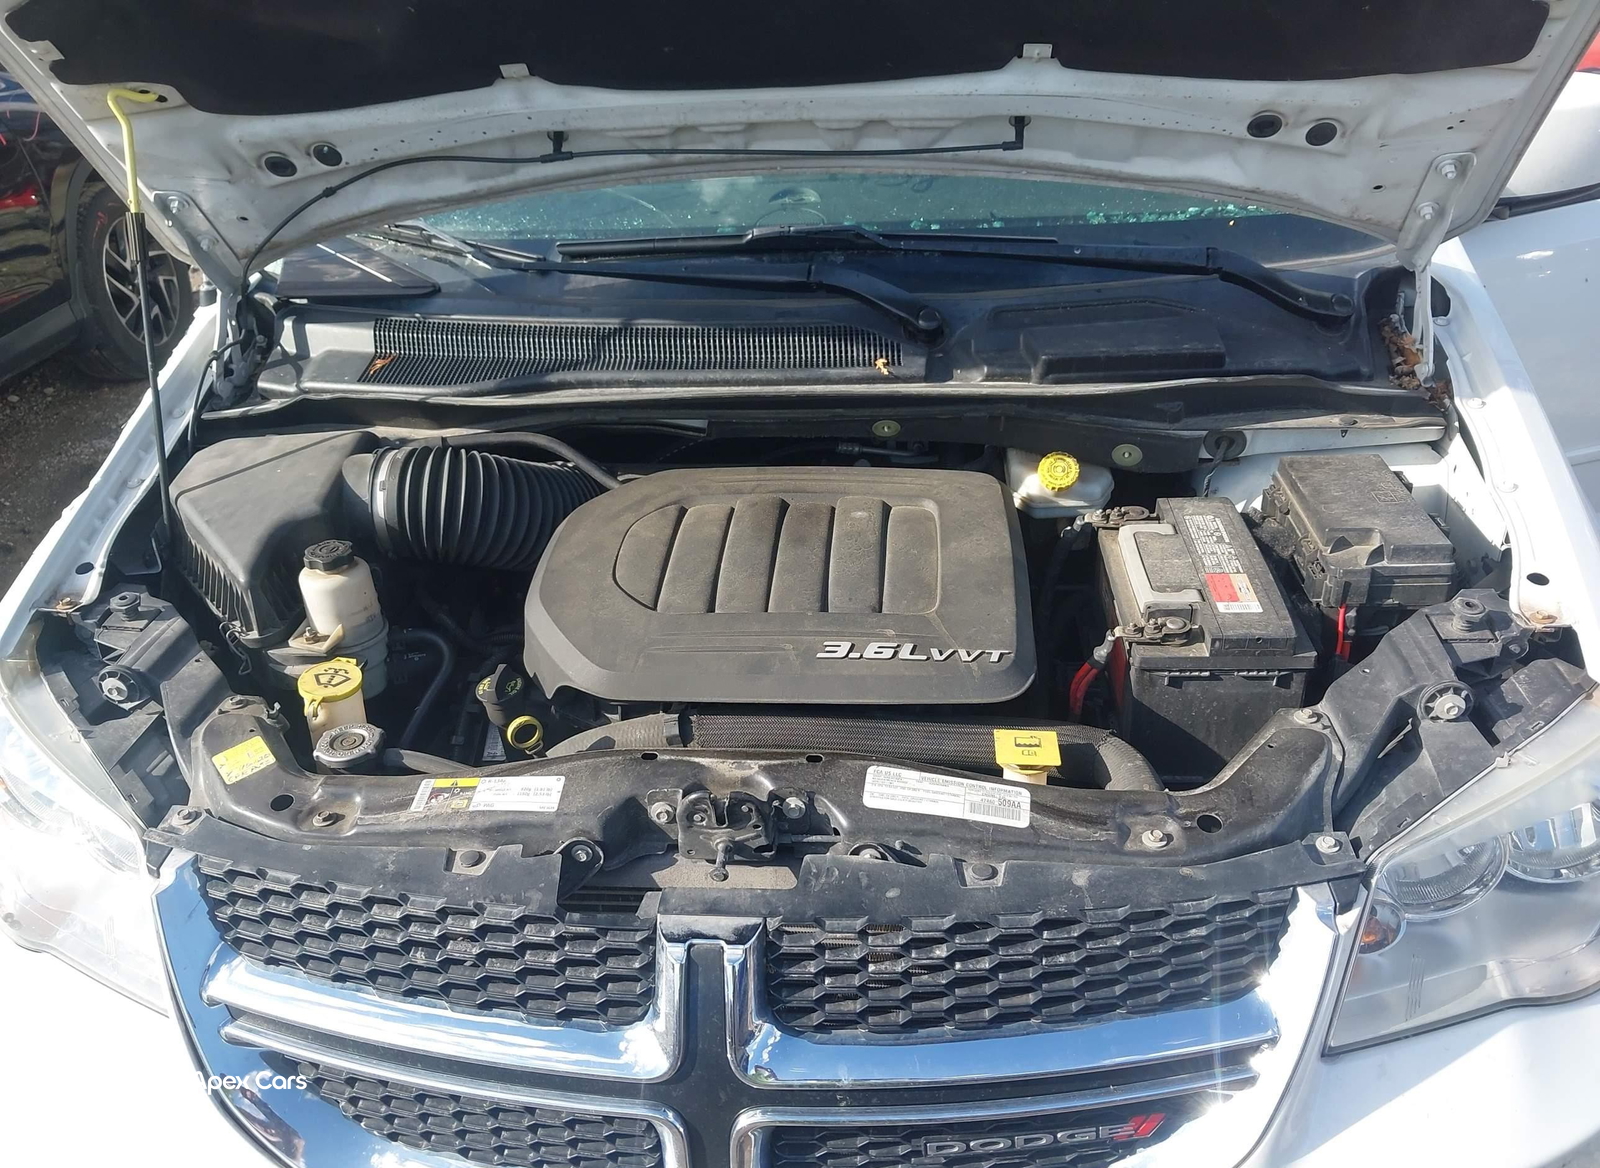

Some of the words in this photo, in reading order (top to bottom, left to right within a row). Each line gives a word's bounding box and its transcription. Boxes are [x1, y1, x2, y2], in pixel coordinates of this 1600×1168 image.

[941, 778, 965, 787] EMISSION
[965, 782, 987, 790] CONTROL
[988, 786, 1023, 796] INFORMATION
[997, 798, 1022, 809] 509AA
[926, 1122, 1136, 1156] DODGE
